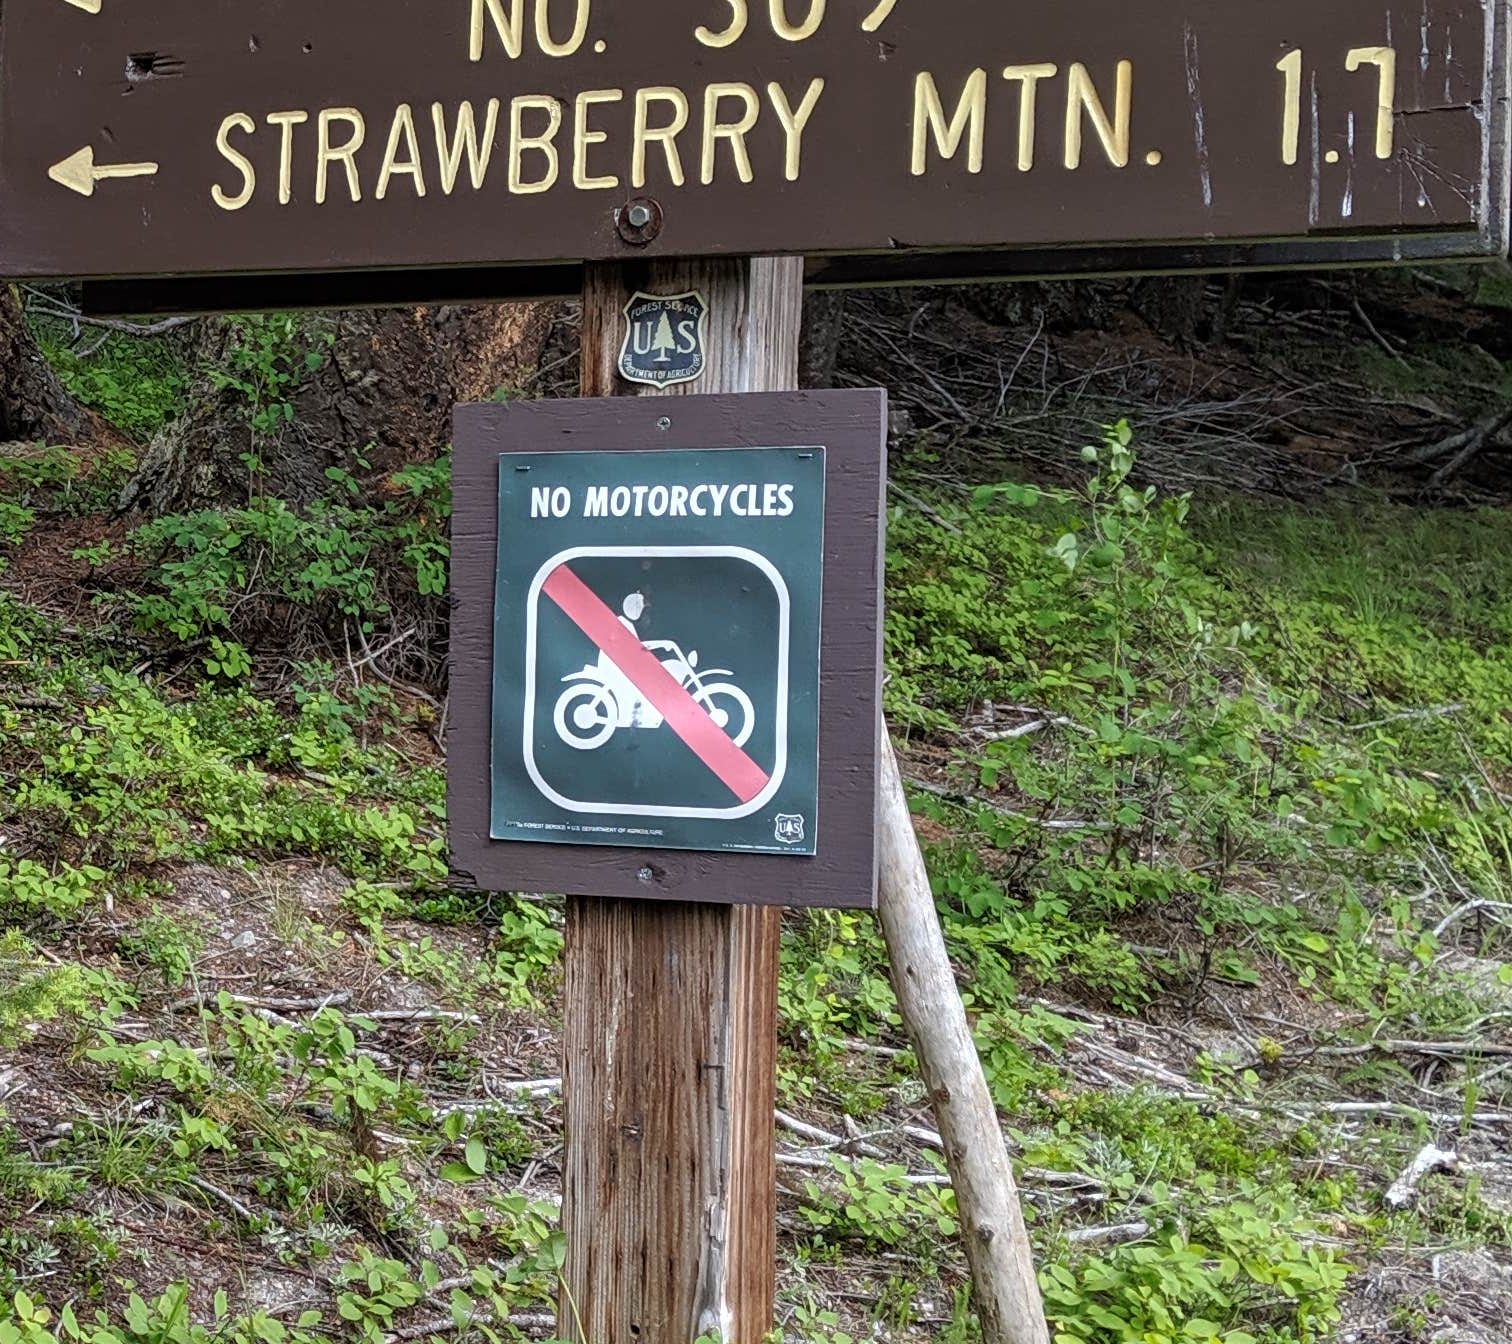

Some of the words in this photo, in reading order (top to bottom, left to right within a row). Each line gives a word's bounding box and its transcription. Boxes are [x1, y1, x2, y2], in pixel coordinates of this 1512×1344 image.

[210, 78, 825, 211] STRAWBERRY
[910, 60, 1161, 176] MTN.
[1275, 46, 1396, 166] 1.7
[631, 301, 662, 319] FOREST
[530, 486, 571, 518] NO
[583, 483, 794, 518] MOTORCYCLES
